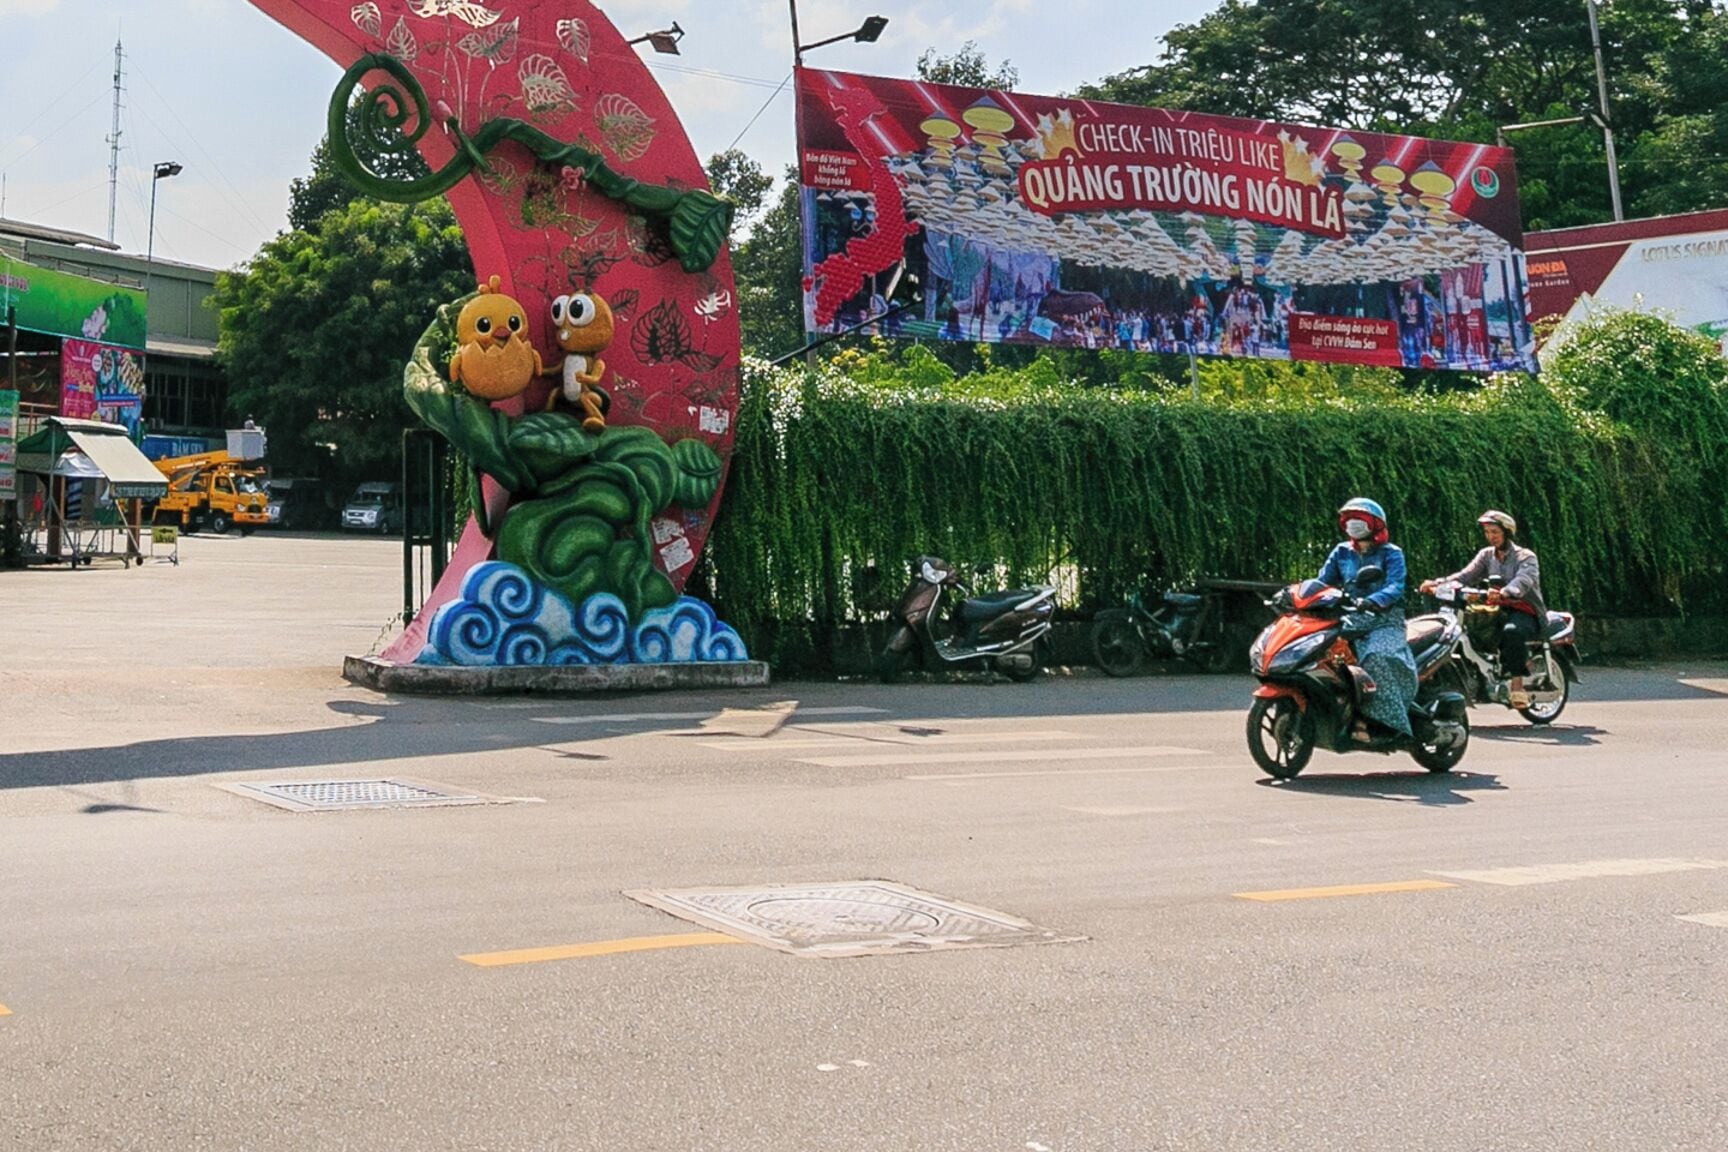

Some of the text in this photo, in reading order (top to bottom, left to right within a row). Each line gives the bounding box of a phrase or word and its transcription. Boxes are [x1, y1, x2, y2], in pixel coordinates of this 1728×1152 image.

[1079, 123, 1281, 172] CHECK-IN TRIỆU LIKE
[1024, 155, 1342, 232] QUẢNG TRƯỜNG NÓN LÁ
[1641, 244, 1681, 262] LOTUS
[1363, 338, 1377, 350] Sen
